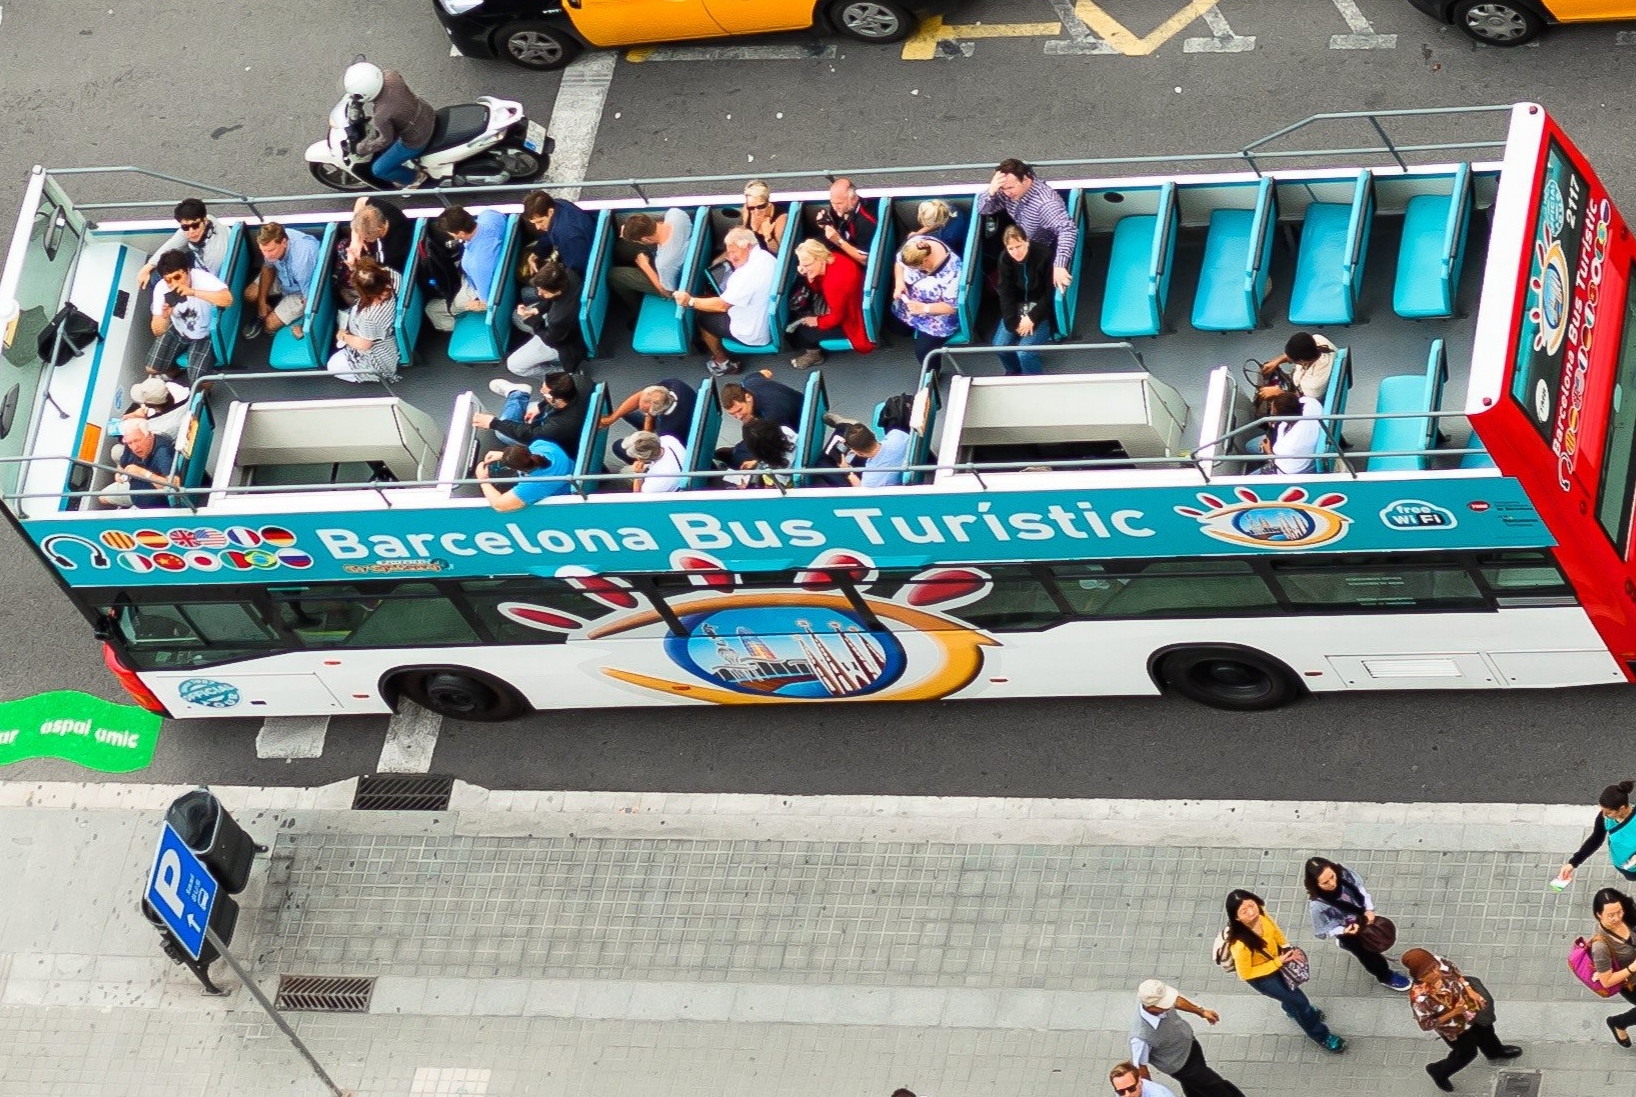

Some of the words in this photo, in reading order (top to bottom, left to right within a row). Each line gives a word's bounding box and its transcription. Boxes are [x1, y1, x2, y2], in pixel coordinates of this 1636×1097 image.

[1566, 173, 1580, 229] 2117
[1552, 350, 1575, 458] Barcelona
[1568, 296, 1583, 346] Bus
[315, 522, 659, 560] Barcelona
[669, 512, 826, 552] Bus
[832, 501, 1156, 545] Turístic
[154, 848, 185, 919] P
